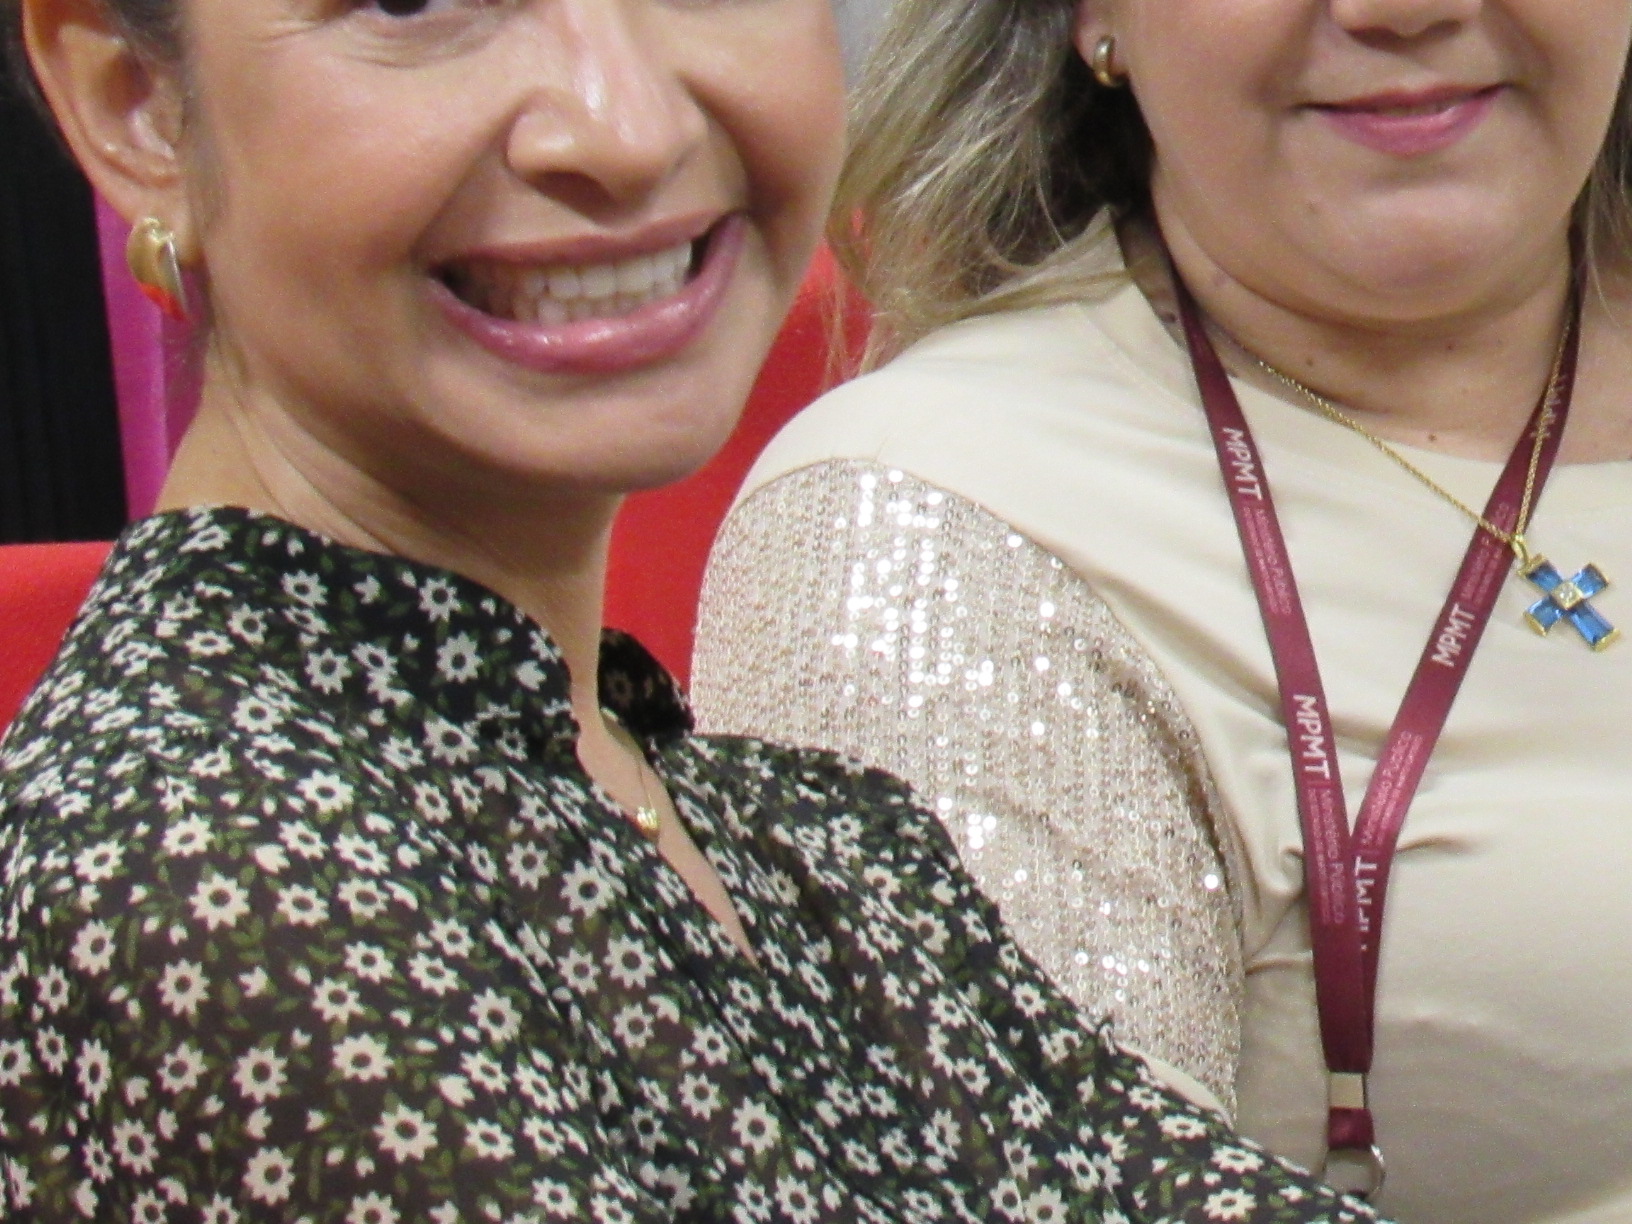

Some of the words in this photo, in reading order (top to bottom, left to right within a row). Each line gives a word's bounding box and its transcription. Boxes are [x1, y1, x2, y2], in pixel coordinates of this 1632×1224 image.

[1223, 427, 1264, 501] MPMT
[1431, 602, 1476, 668] MPMT
[1293, 694, 1330, 780] MPMT
